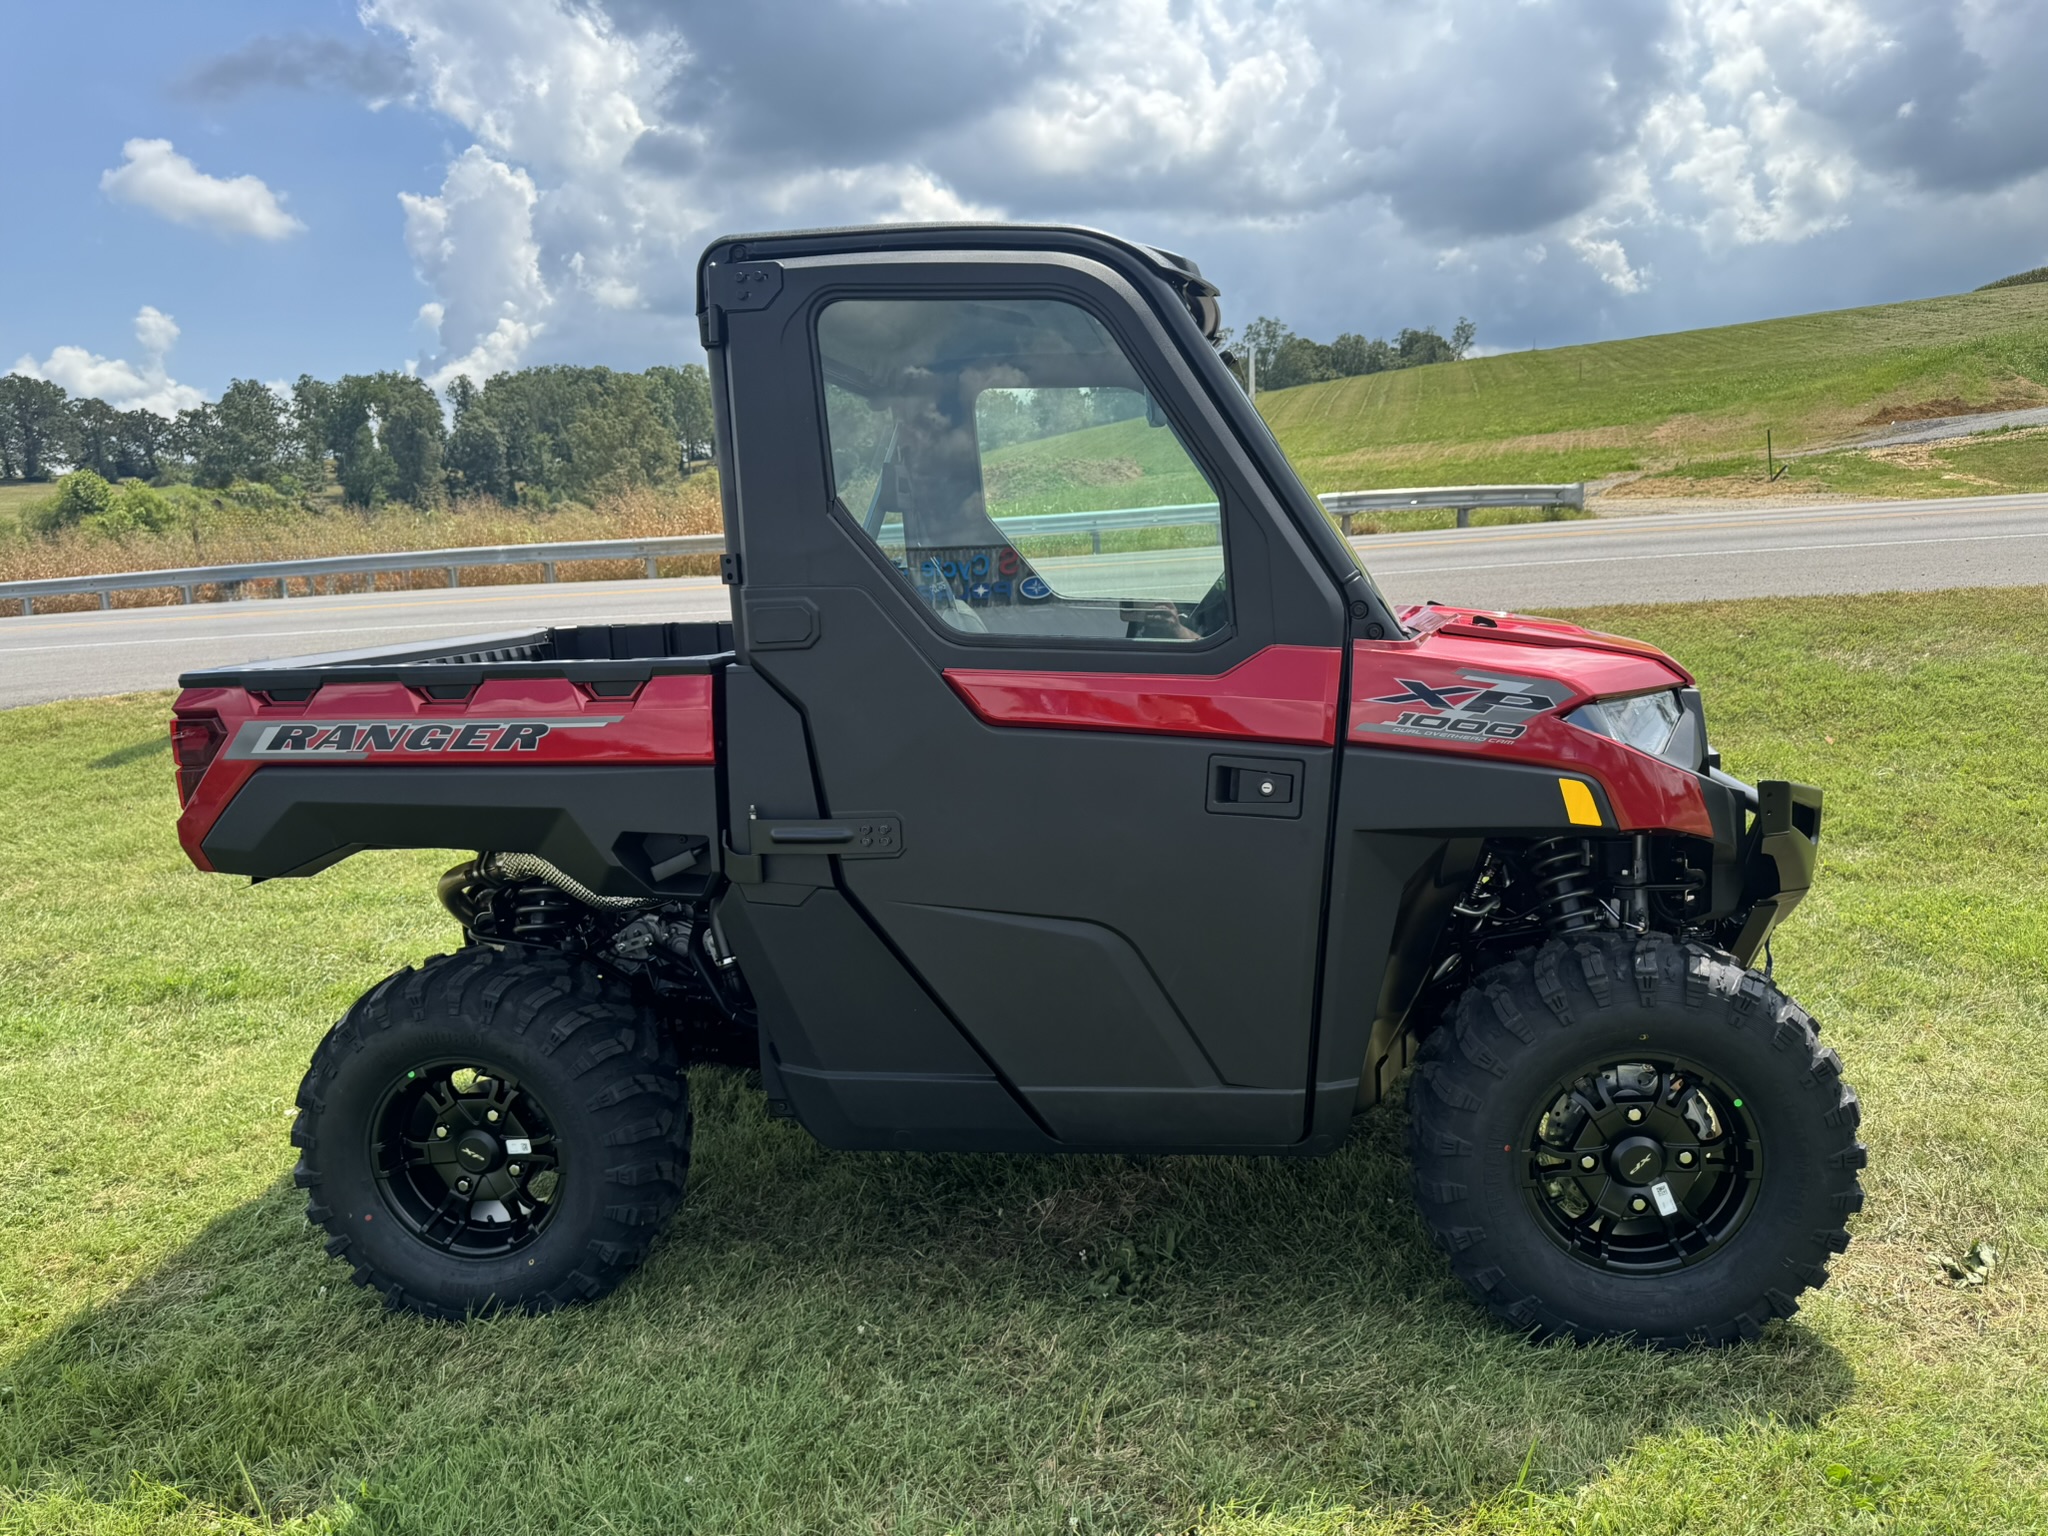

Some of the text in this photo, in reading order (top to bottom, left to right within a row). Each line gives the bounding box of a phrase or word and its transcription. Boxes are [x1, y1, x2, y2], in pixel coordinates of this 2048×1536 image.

[1363, 678, 1556, 714] XP
[265, 722, 551, 752] RANGER
[1391, 727, 1515, 746] DUAL OVERHEAD CAM
[1396, 711, 1527, 739] 1000
[1629, 1152, 1652, 1176] XP
